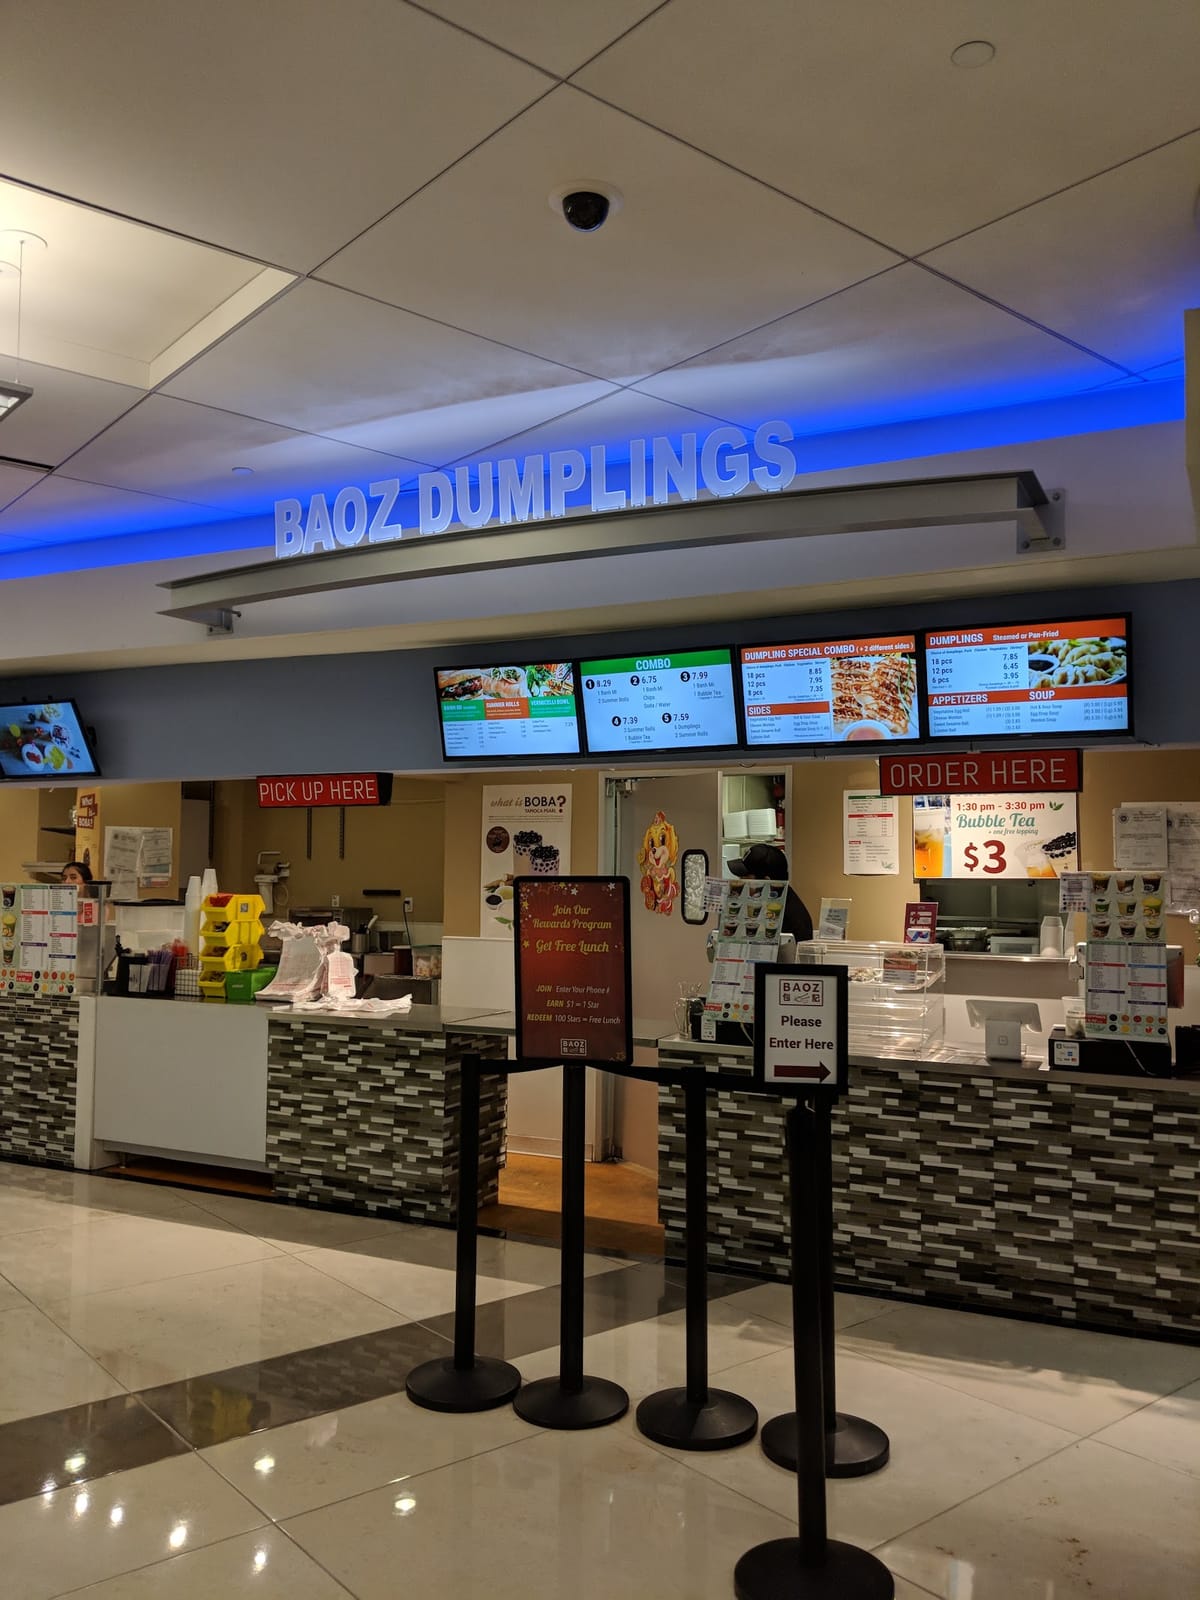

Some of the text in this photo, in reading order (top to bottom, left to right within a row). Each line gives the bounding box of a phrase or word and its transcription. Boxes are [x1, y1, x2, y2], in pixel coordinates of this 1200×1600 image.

[275, 420, 797, 558] BAOZ DUMPLINGS
[930, 634, 983, 646] DUMPLINGS
[993, 633, 1020, 641] Steamed
[1028, 630, 1059, 638] Pan-Fried
[744, 650, 786, 660] DUMPLING
[788, 647, 822, 658] SPECIAL
[824, 644, 855, 655] COMBO
[635, 658, 671, 671] COMBO
[940, 658, 952, 666] pcs
[1003, 653, 1018, 661] 7.85
[692, 671, 708, 680] 7.99
[755, 672, 766, 680] pcs
[932, 667, 940, 675] 12
[941, 668, 953, 676] pcs
[642, 676, 657, 684] 6.75
[938, 677, 949, 685] pcs
[1004, 671, 1019, 680] 3.95
[755, 681, 766, 689] pcs
[932, 691, 1055, 705] APPETIZERS SOUP
[748, 706, 771, 715] SIDES
[623, 717, 638, 725] 7.39
[890, 758, 1066, 788] ORDER HERE
[260, 780, 376, 802] PICK UP HERE
[490, 797, 513, 807] what
[515, 797, 523, 807] is
[956, 803, 977, 811] 1:30
[980, 803, 995, 813] pm
[1005, 801, 1027, 810] 3:30
[1029, 802, 1045, 812] pm
[956, 813, 1035, 828] Bubble Tea
[1004, 828, 1015, 836] free
[1016, 828, 1038, 836] topping
[964, 840, 1007, 874] $3
[552, 905, 592, 916] Join Our
[532, 919, 612, 932] Rewards Program
[536, 939, 609, 955] Get Free Lunch
[586, 985, 605, 994] Phone
[783, 982, 820, 993] BAOZ
[546, 1000, 564, 1008] EARN
[587, 1001, 600, 1009] Star
[527, 1014, 552, 1022] REDEEM
[567, 1015, 581, 1023] Stars
[589, 1015, 601, 1023] Free
[603, 1016, 621, 1024] Lunch
[781, 1015, 822, 1027] Please
[562, 1040, 585, 1048] BAOZ
[769, 1037, 834, 1050] Enter Here
